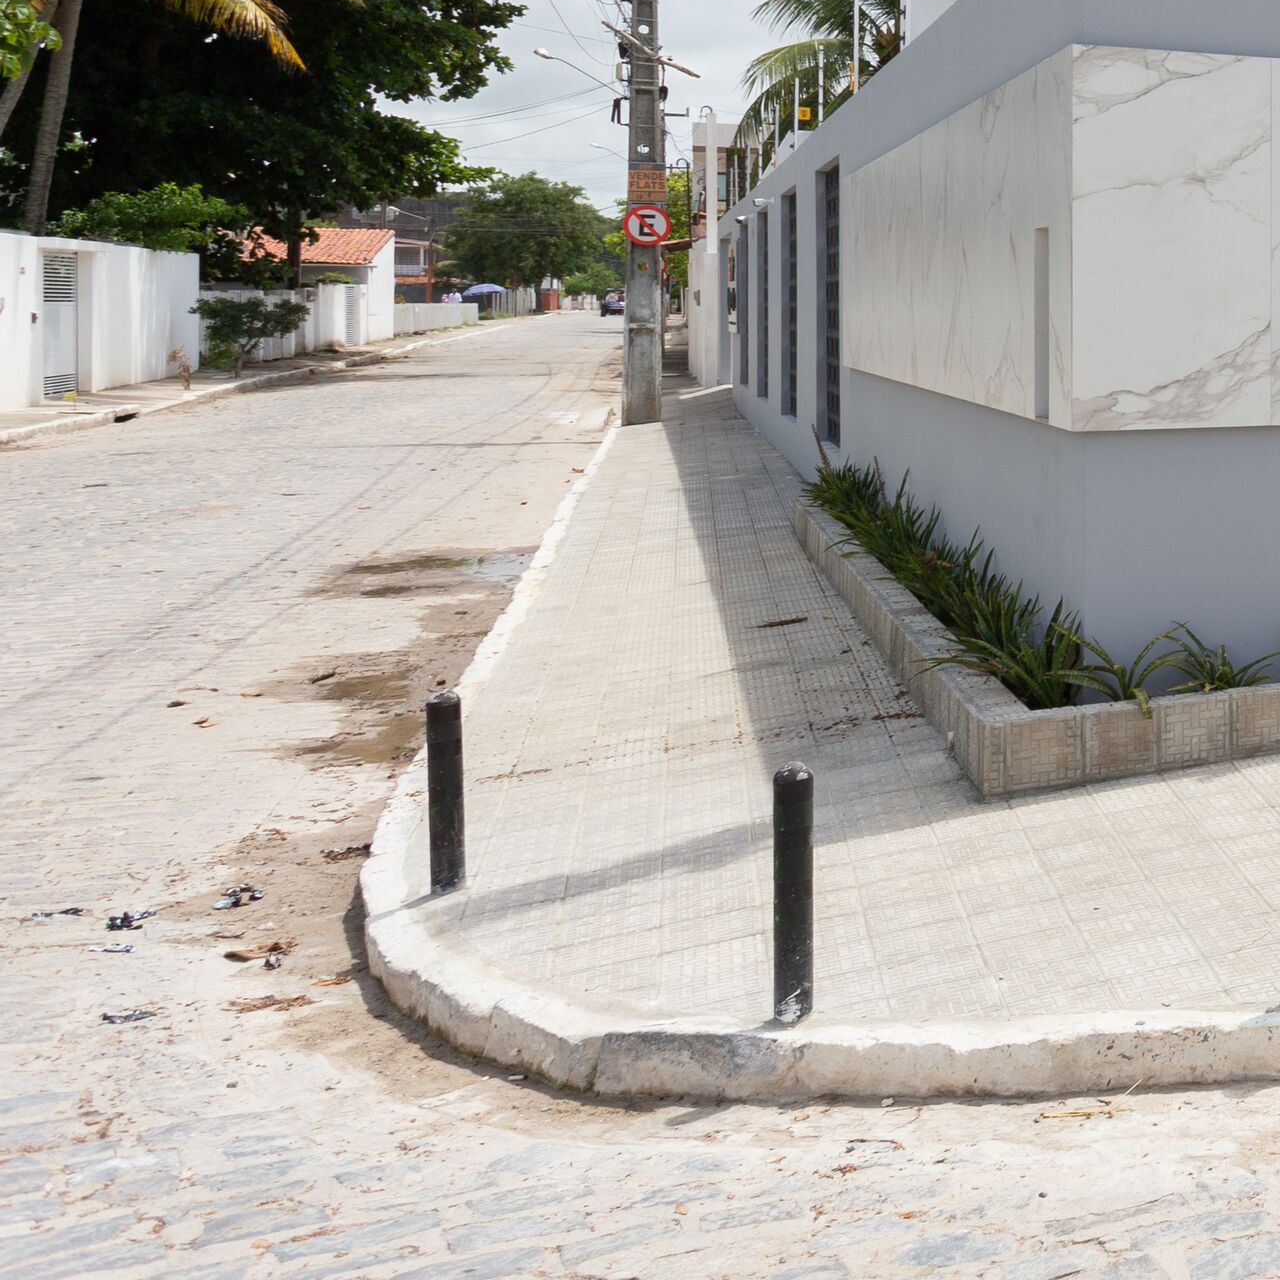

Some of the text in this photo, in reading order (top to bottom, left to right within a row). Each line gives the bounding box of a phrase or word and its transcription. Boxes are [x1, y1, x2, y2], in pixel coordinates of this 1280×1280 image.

[630, 171, 666, 180] VENDE
[630, 181, 666, 190] FLATS
[638, 214, 656, 236] E
